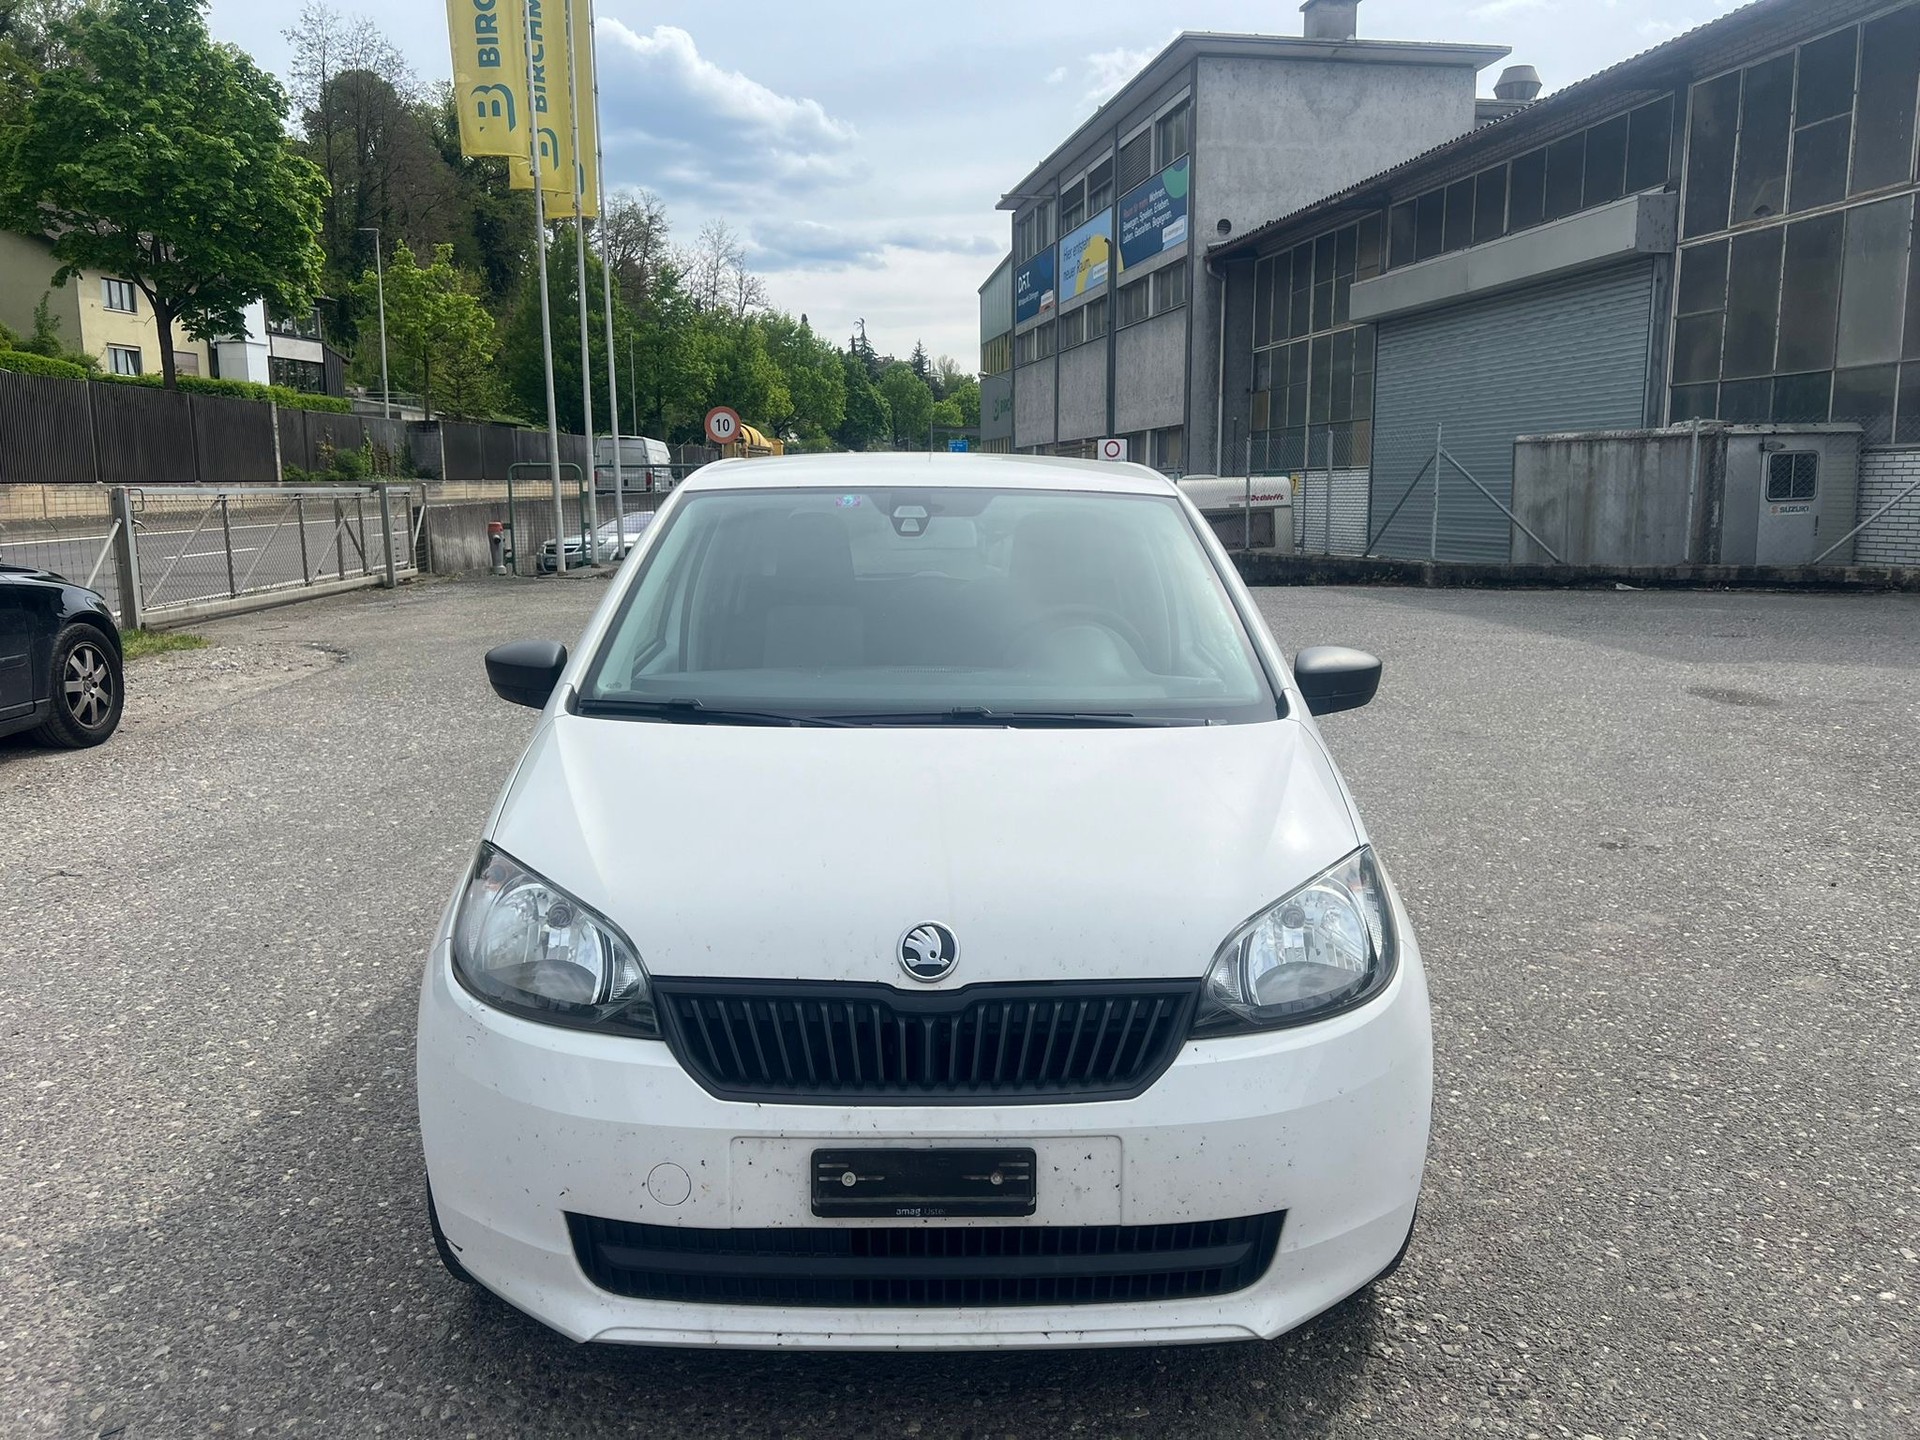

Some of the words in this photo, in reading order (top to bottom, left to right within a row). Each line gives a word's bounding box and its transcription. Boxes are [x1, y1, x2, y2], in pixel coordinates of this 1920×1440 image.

[716, 419, 730, 431] 10
[1780, 505, 1809, 513] SUZUKI
[896, 1208, 921, 1217] amag
